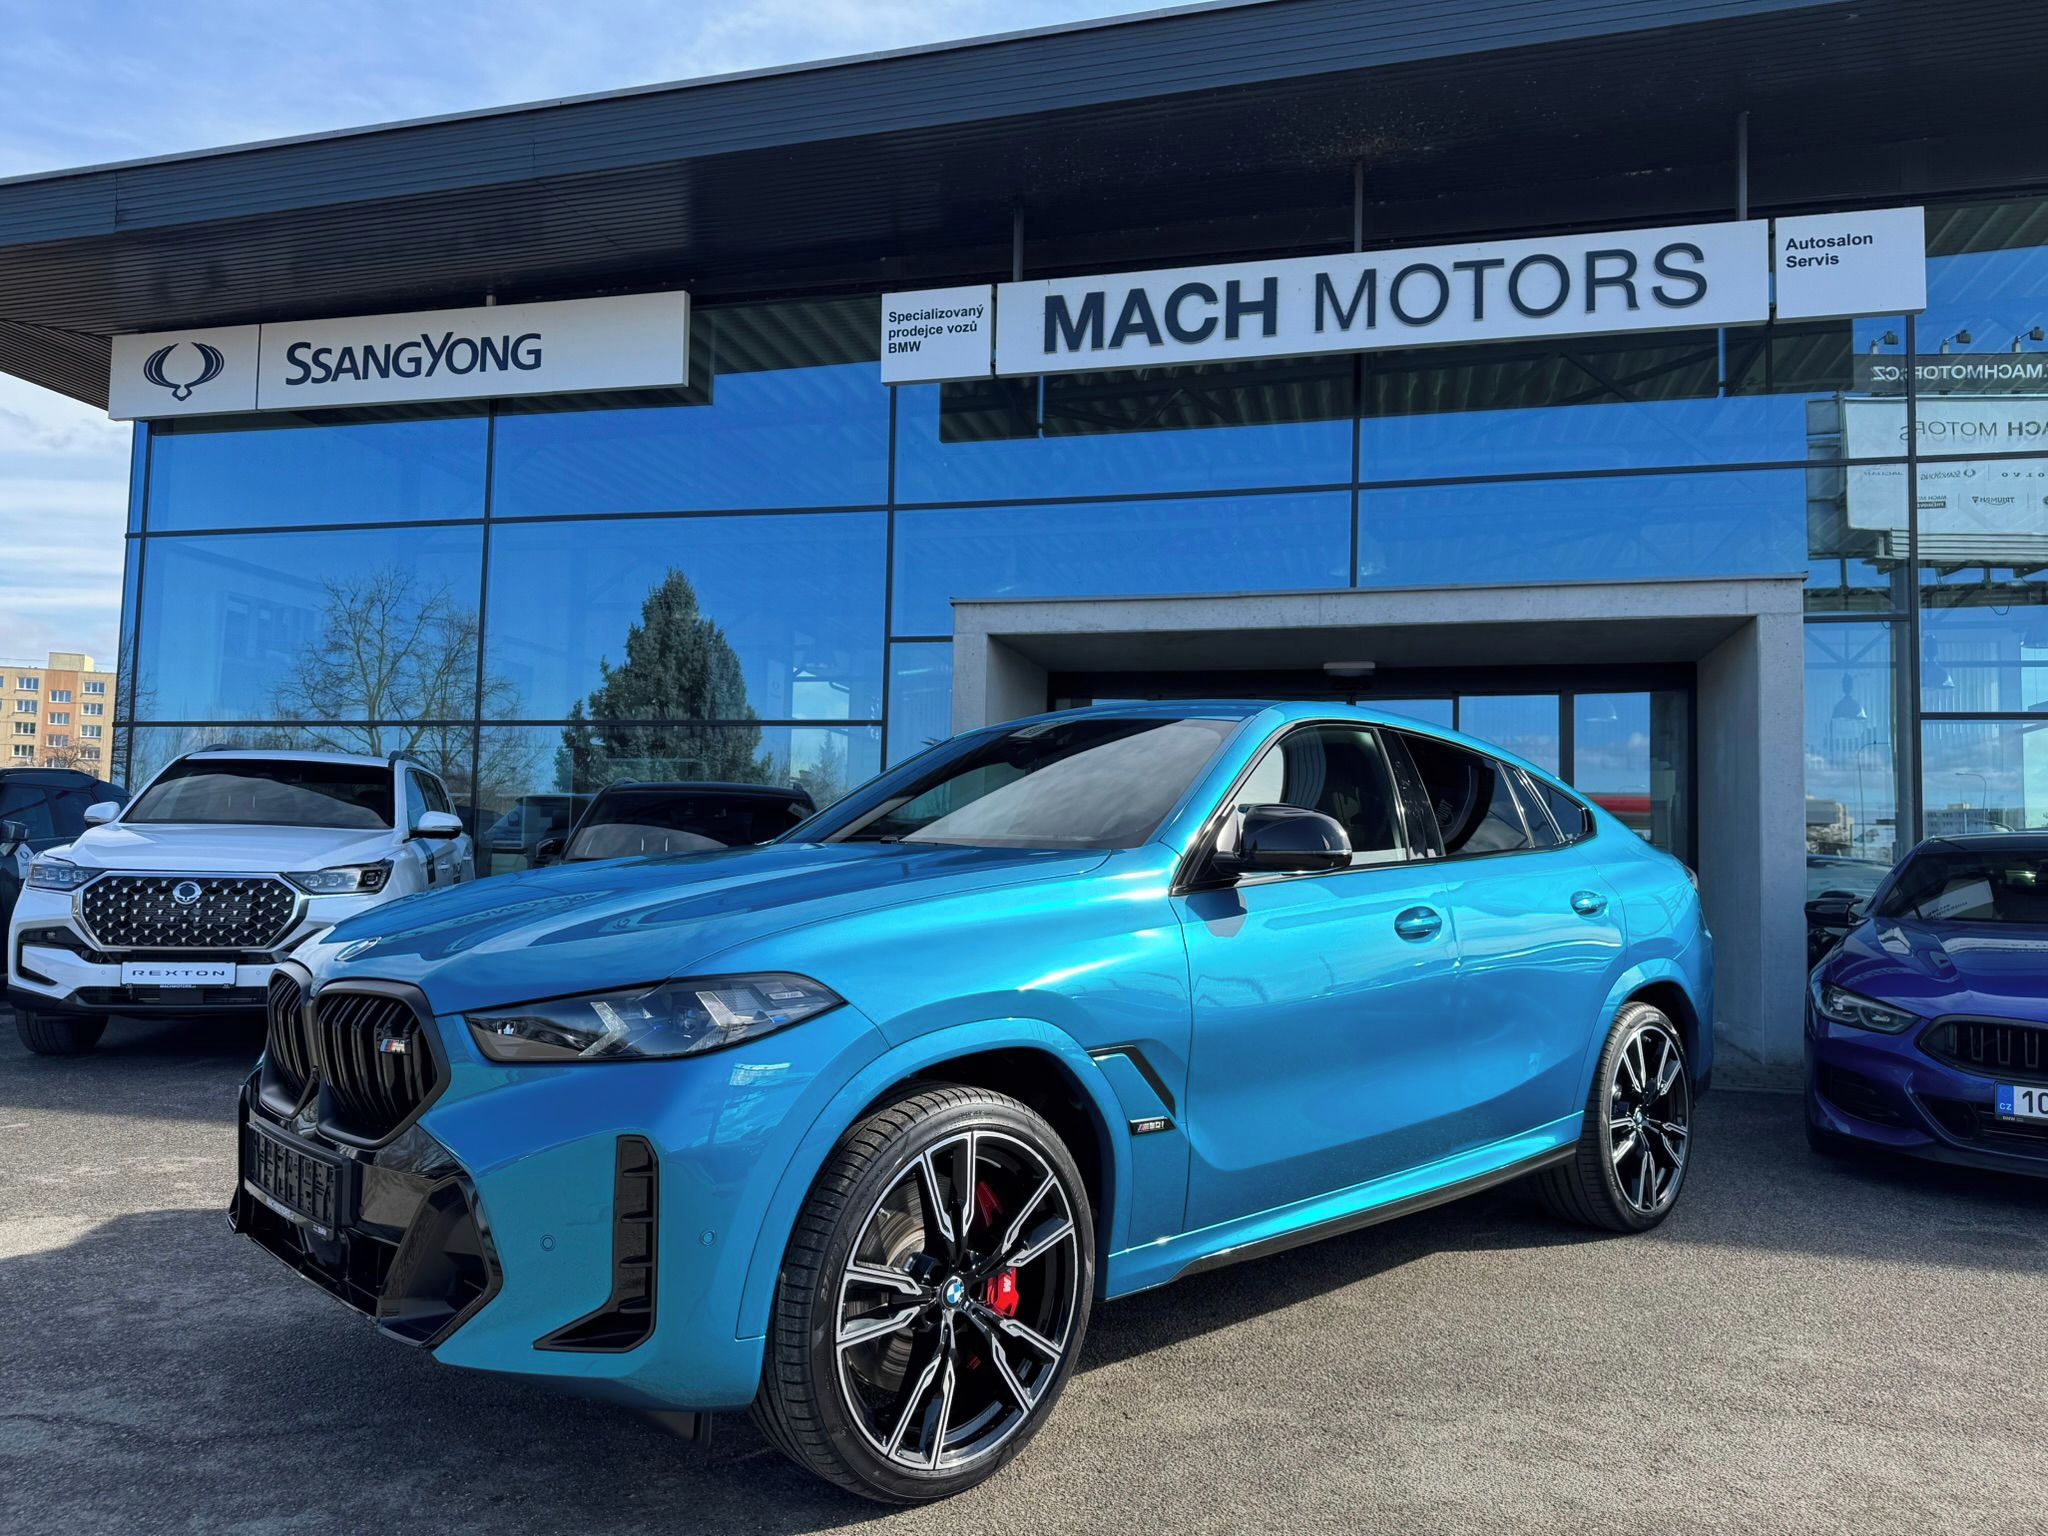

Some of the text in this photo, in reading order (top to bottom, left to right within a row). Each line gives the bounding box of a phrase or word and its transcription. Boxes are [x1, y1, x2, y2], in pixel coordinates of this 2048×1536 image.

[1785, 233, 1873, 251] Autosalon
[1786, 253, 1840, 269] Servis
[1043, 242, 1708, 355] MACH MOTORS
[888, 303, 984, 325] Specializovaný
[888, 320, 978, 341] prodejce vozů
[888, 340, 922, 354] BMW
